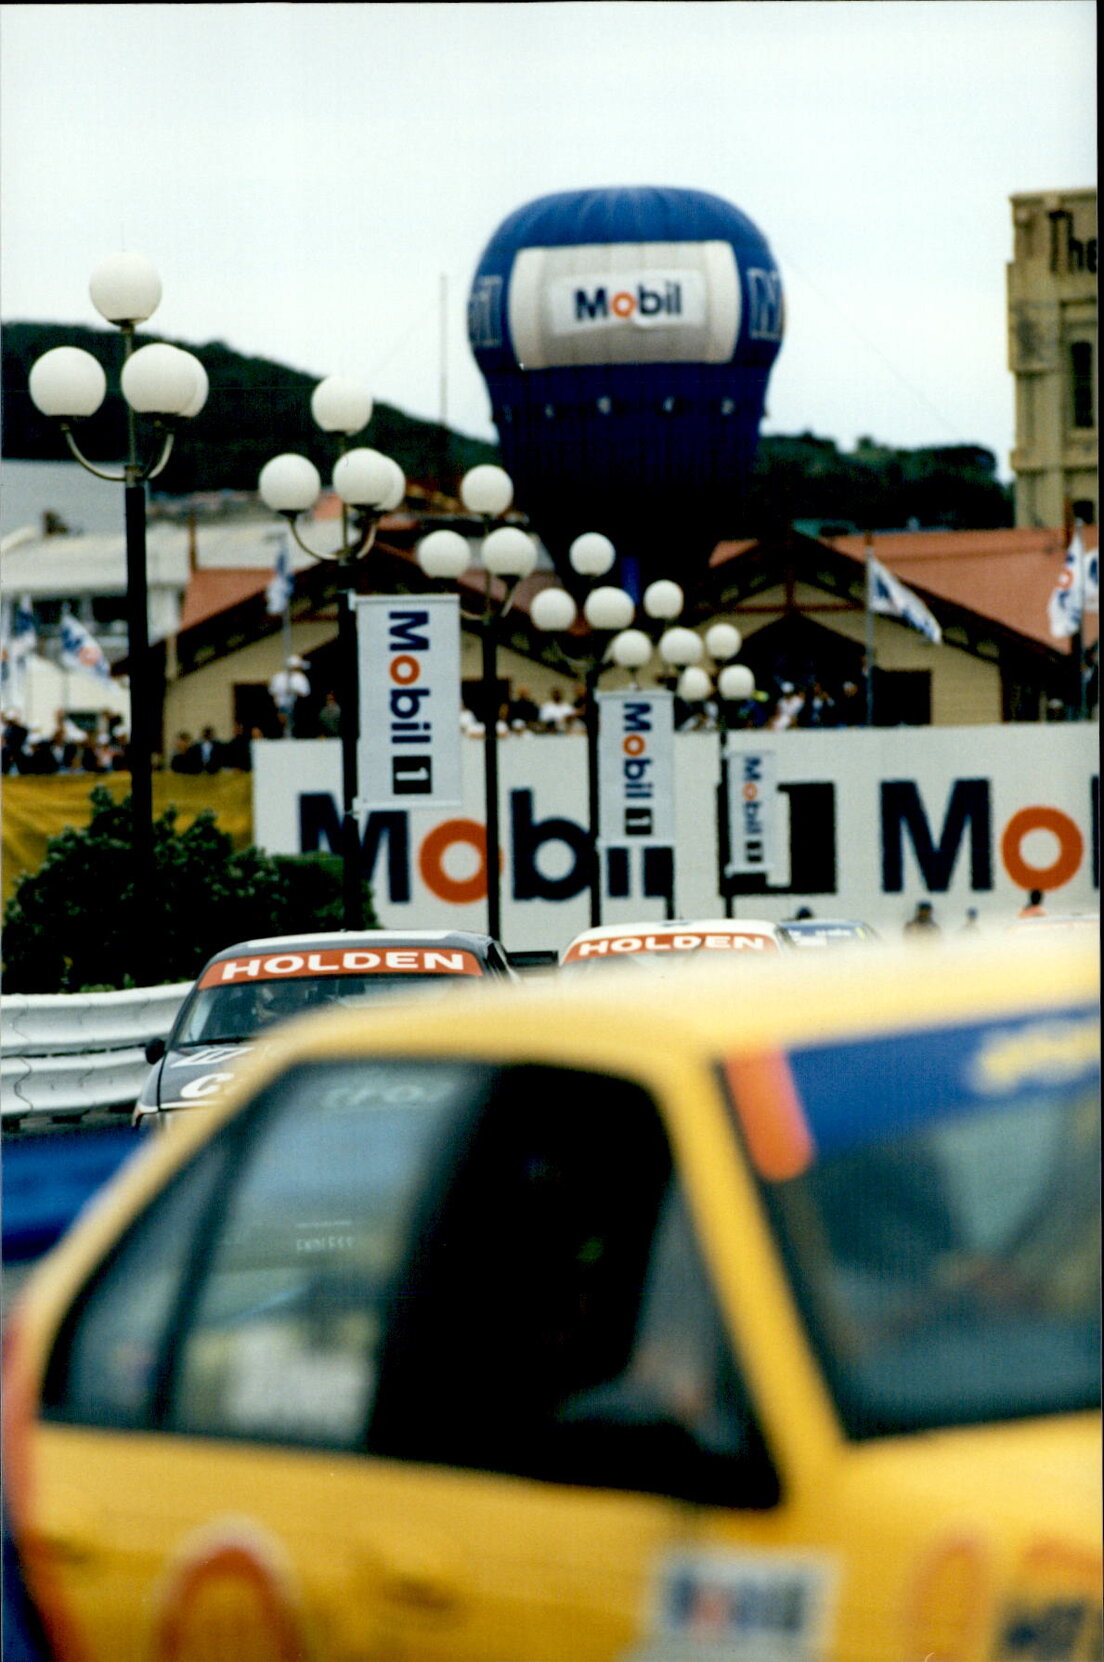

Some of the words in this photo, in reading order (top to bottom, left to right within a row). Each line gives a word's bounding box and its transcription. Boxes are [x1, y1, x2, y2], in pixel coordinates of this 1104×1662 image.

[574, 280, 683, 322] Mobil
[389, 610, 432, 744] Mobil
[623, 702, 653, 799] Mobil
[742, 756, 763, 835] Mobil
[880, 775, 1098, 892] Mo
[221, 951, 465, 981] HOLDEN
[578, 934, 765, 956] HOLDEN
